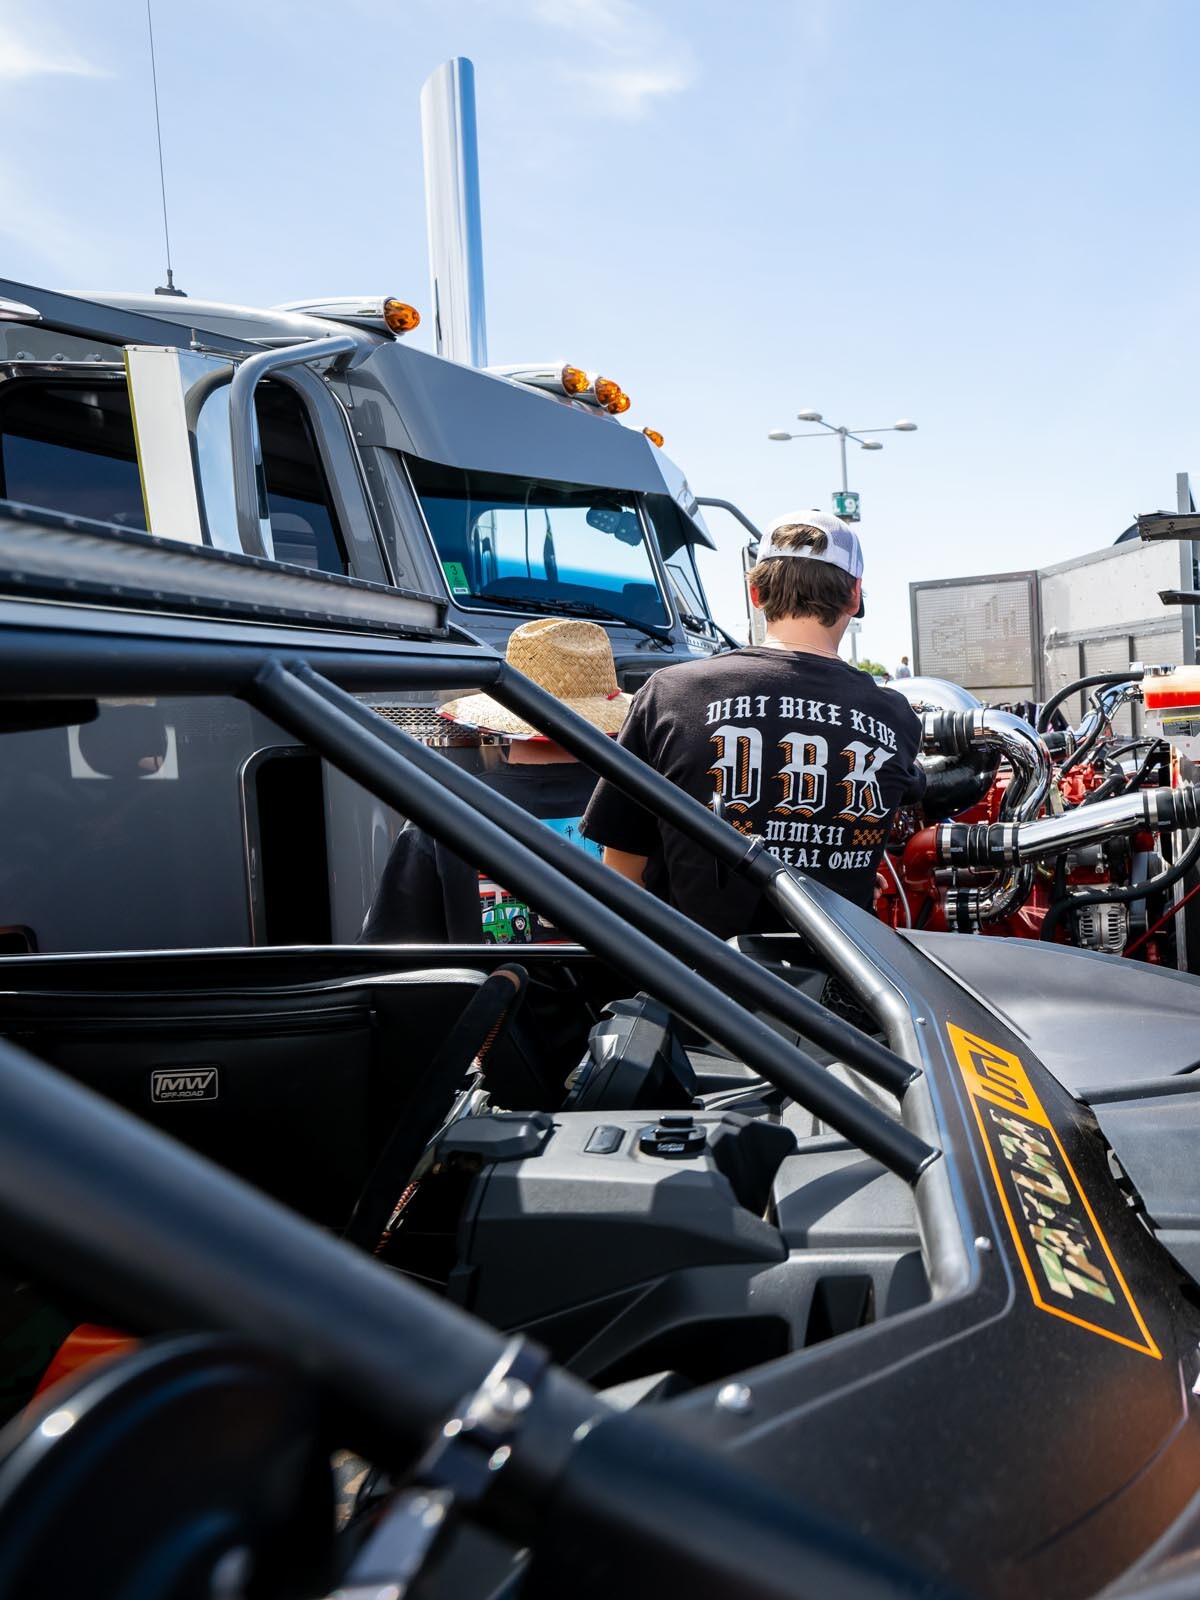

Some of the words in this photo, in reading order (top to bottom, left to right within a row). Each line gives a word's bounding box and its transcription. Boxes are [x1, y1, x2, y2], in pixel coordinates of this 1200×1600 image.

[450, 565, 458, 575] 3
[704, 695, 771, 726] DIRT
[778, 696, 843, 726] BIKE
[850, 709, 898, 751] KIDZ
[765, 820, 845, 847] MMXII
[828, 850, 873, 870] ONES
[990, 1108, 1116, 1305] TATUM
